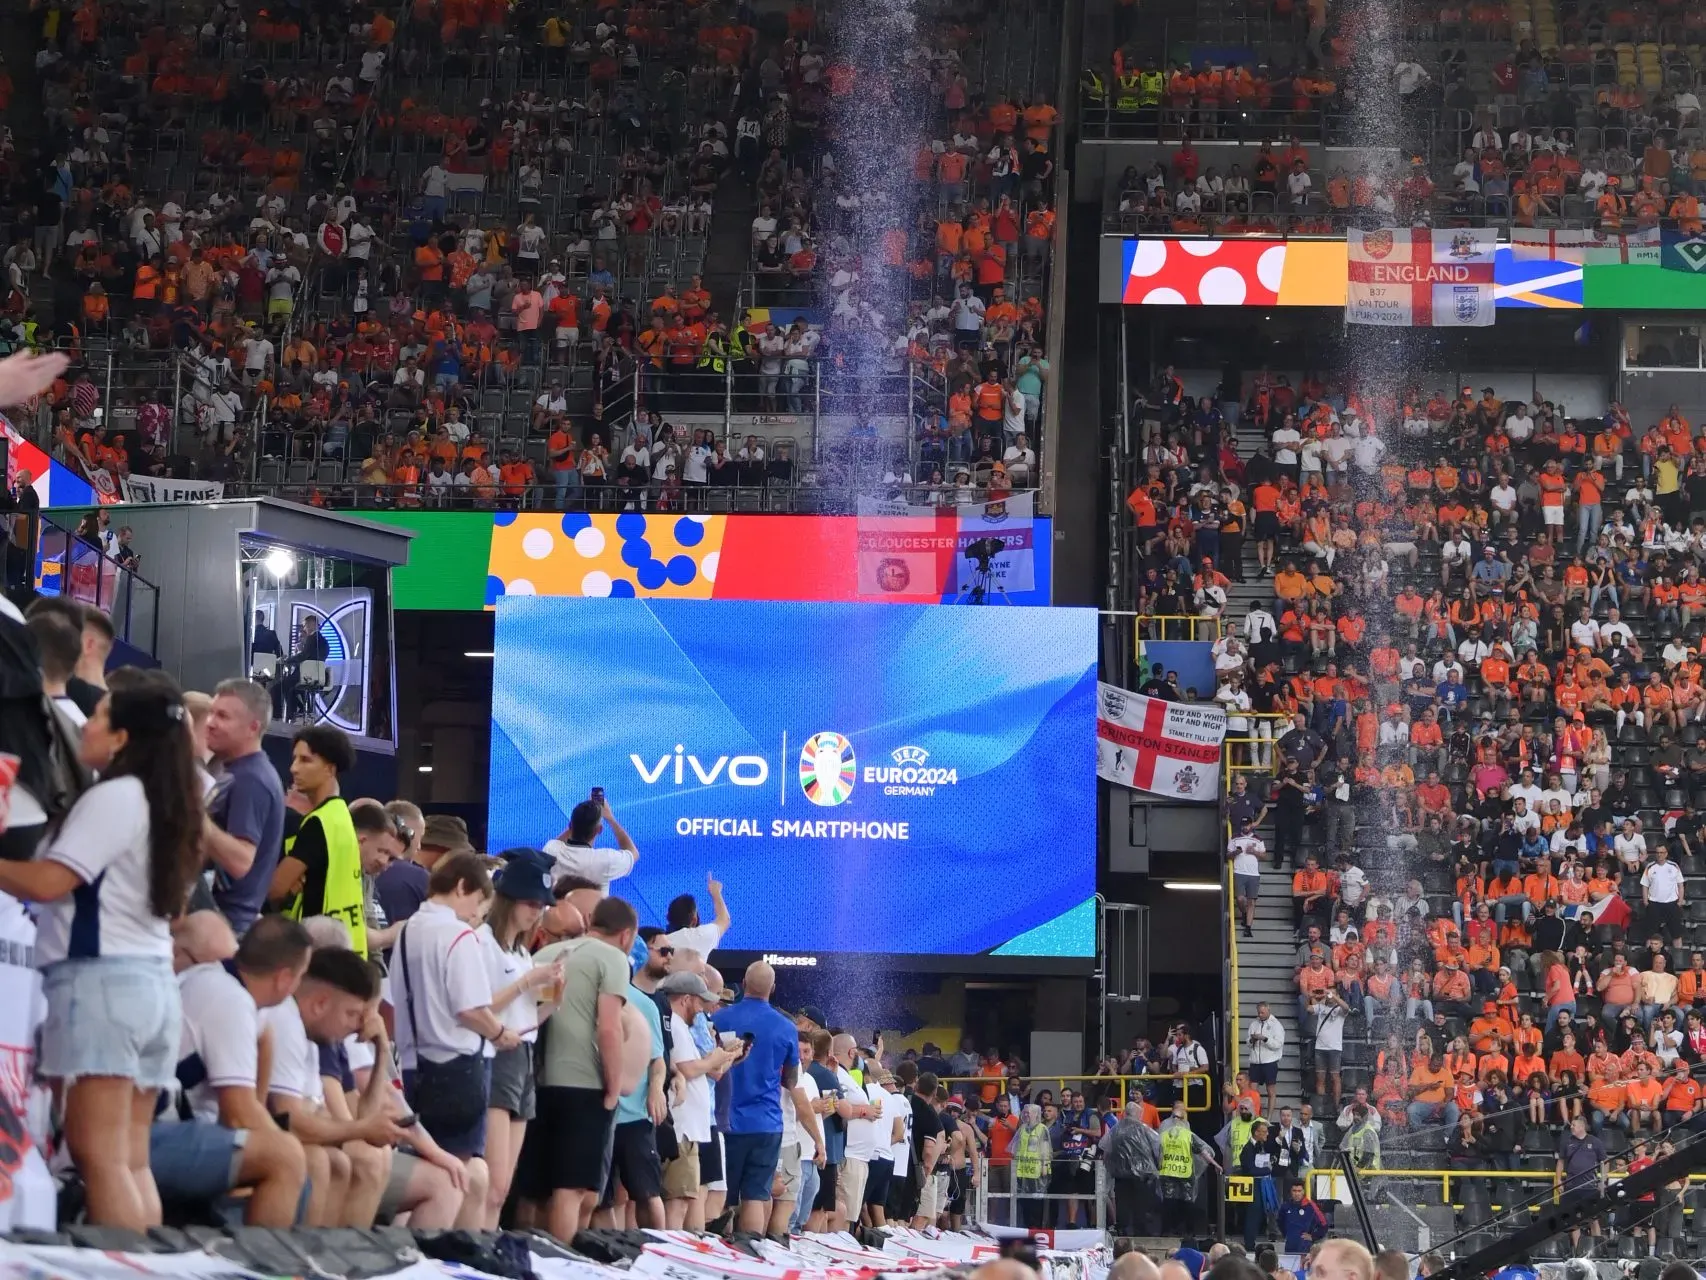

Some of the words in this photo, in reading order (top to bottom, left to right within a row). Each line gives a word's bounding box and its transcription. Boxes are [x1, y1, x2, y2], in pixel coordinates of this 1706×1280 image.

[1374, 265, 1469, 282] ENGLAND
[1370, 288, 1386, 297] B37
[1359, 299, 1373, 308] ON
[1374, 300, 1399, 309] TOUR
[868, 537, 954, 549] GLOUCESTER
[1170, 708, 1185, 716] RED
[1186, 710, 1202, 718] AND
[1170, 716, 1184, 724] DAY
[1185, 719, 1201, 727] AND
[1202, 722, 1223, 731] NIGH
[1168, 729, 1193, 739] STANLEY
[893, 749, 926, 766] UEFA
[1164, 743, 1217, 760] STANLEY
[629, 743, 769, 786] vivo
[863, 766, 958, 785] EURO2024
[883, 785, 936, 797] GERMANY
[675, 817, 764, 837] OFFICIAL
[771, 819, 910, 840] SMARTPHONE
[762, 953, 818, 966] Hisense
